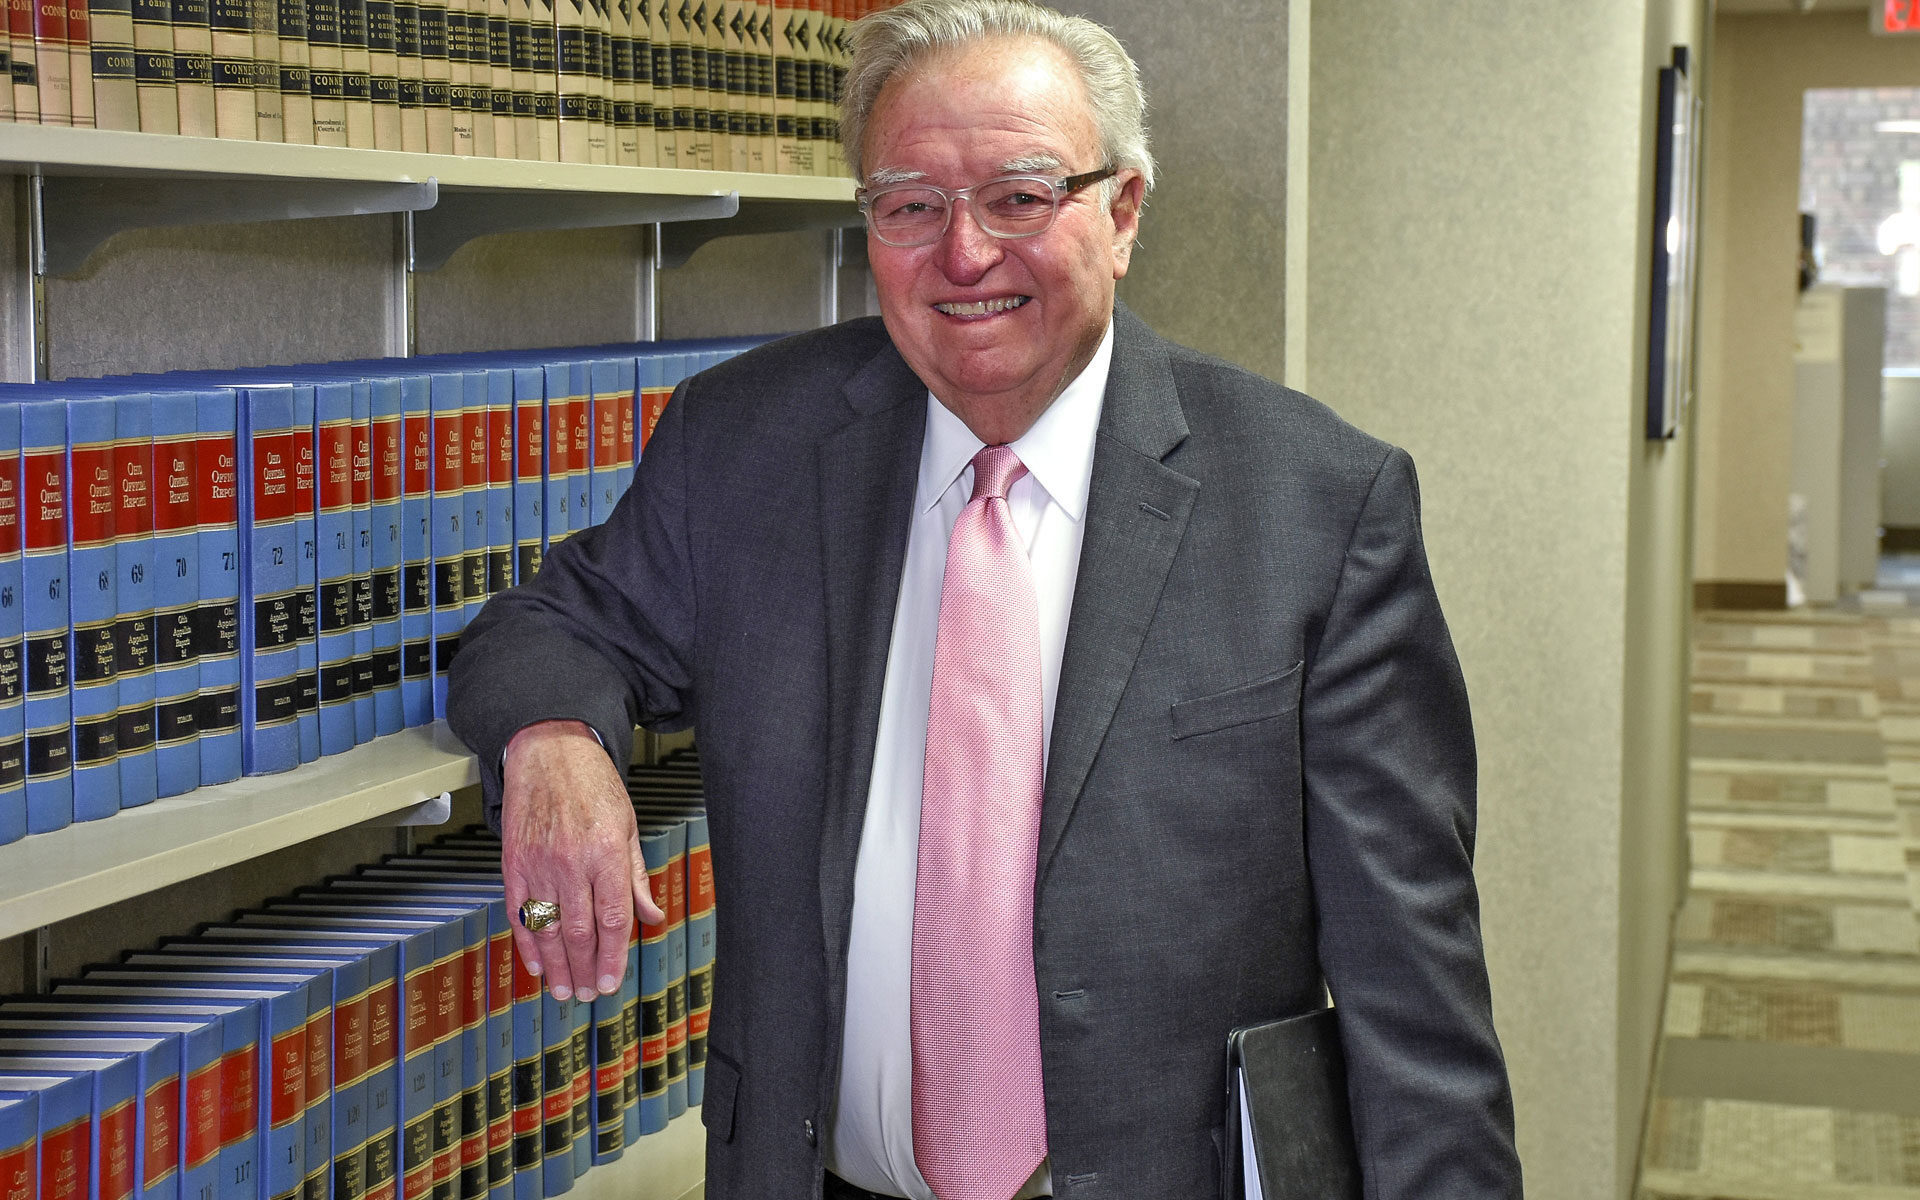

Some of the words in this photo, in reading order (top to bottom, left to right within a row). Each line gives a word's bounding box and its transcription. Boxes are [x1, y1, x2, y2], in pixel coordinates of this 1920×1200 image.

[336, 532, 345, 550] 74
[222, 552, 235, 571] 71
[272, 546, 283, 565] 72
[132, 564, 144, 584] 69
[176, 557, 187, 578] 70
[2, 586, 13, 608] 66
[49, 578, 60, 600] 67
[414, 1072, 425, 1092] 122
[235, 1160, 250, 1184] 117
